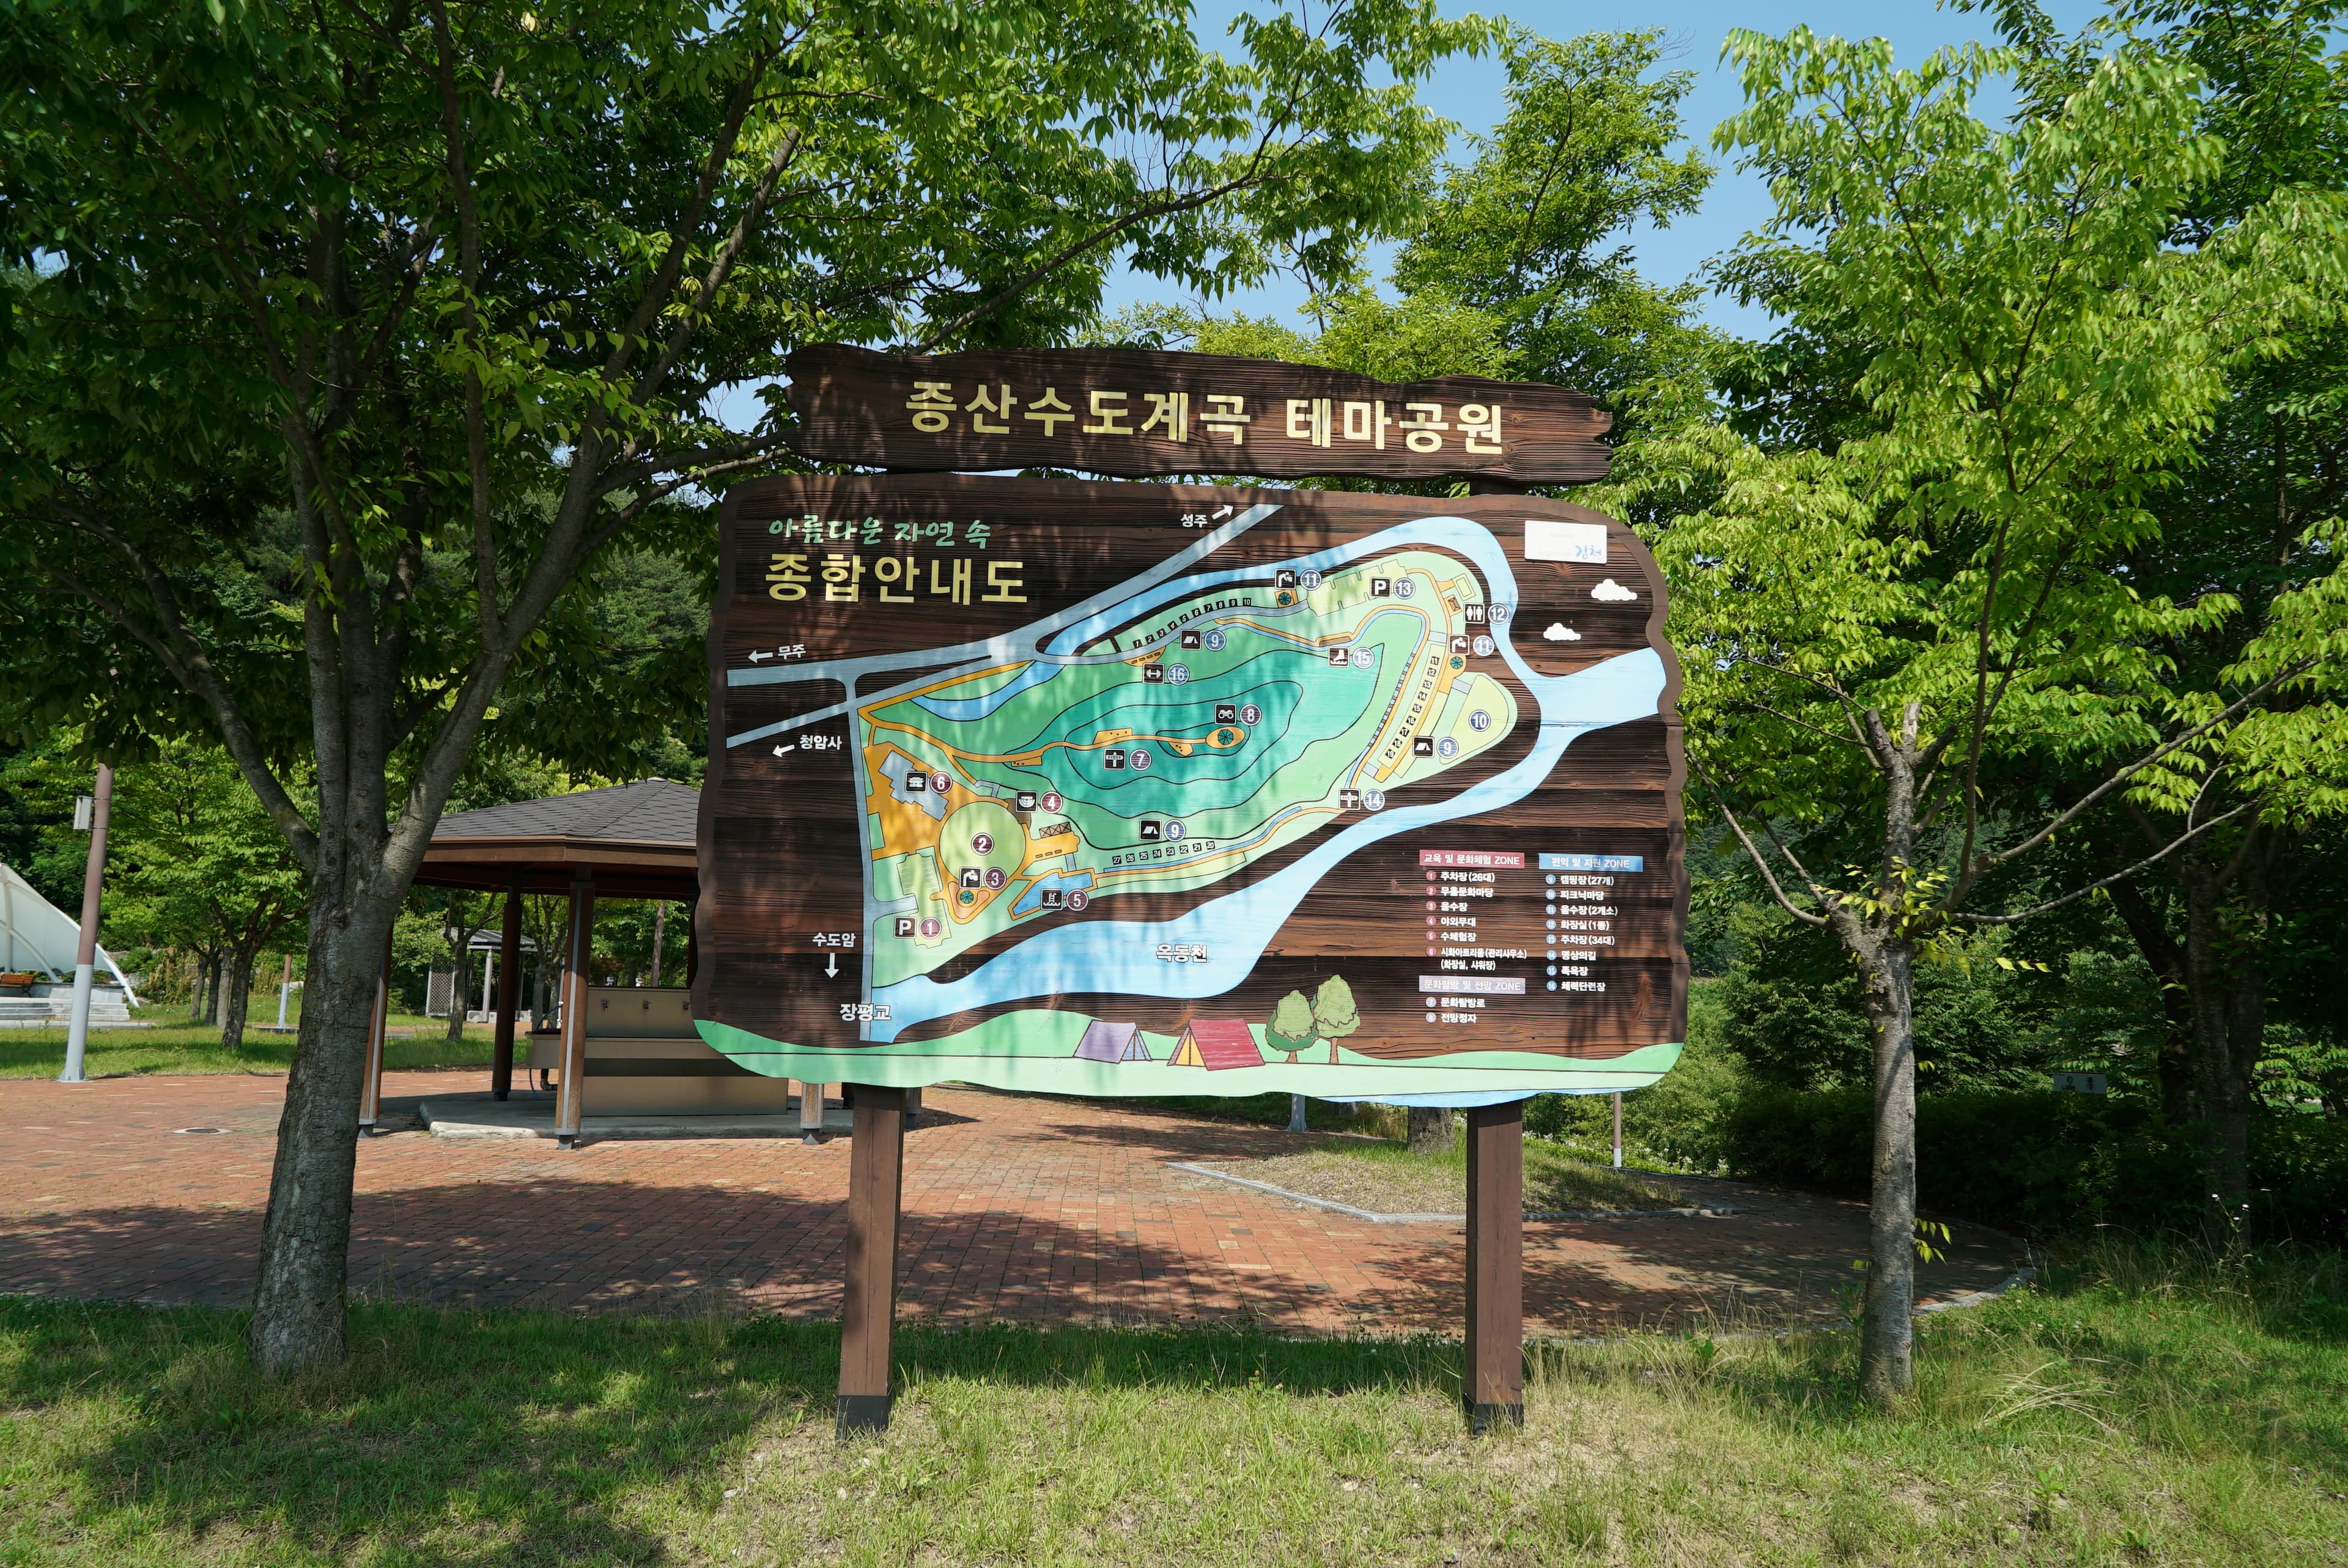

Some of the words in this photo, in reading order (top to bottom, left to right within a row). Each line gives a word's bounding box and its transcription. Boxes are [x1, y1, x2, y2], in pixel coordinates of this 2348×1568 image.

[906, 381, 1250, 445] 증산수도계곡
[1286, 397, 1503, 455] 테마공원
[1181, 513, 1208, 528] 성주
[769, 514, 884, 545] 아름다운
[893, 521, 954, 547] 자연
[964, 519, 991, 549] 속
[765, 553, 1028, 605] 종합안내도
[777, 643, 807, 660] 무주
[799, 734, 843, 751] 청암사
[1423, 853, 1442, 864] 교육
[1445, 853, 1453, 864] 및
[1456, 854, 1491, 865] 문화체험
[1494, 856, 1520, 866] ZONE
[1551, 856, 1568, 867] 편의
[1571, 857, 1581, 867] 및
[1584, 858, 1601, 868] 지원
[1604, 859, 1630, 868] ZONE
[1440, 871, 1496, 883] 주차장(26대)
[1560, 875, 1614, 886] 캠핑장(27개)
[1560, 889, 1605, 901] 피크닉마당
[1440, 902, 1468, 912] 음수장
[1560, 905, 1618, 916] 음수장(2개소)
[1441, 917, 1477, 927] 야외무대
[1560, 919, 1610, 931] 화장실(1동)
[812, 932, 856, 948] 수도암
[1440, 932, 1477, 942] 수체험장
[1560, 935, 1615, 946] 주차장(34대)
[1155, 943, 1208, 963] 옥동천
[1561, 951, 1597, 961] 명상의길
[1561, 965, 1589, 976] 족욕장
[1423, 979, 1460, 990] 문화탐방
[1462, 980, 1471, 990] 및
[1475, 981, 1493, 991] 전망
[1495, 982, 1521, 991] ZONE
[1561, 981, 1606, 992] 체력단련장
[1440, 997, 1486, 1008] 문화탐방로
[839, 1003, 892, 1021] 장평교
[1441, 1012, 1477, 1023] 전망정자
